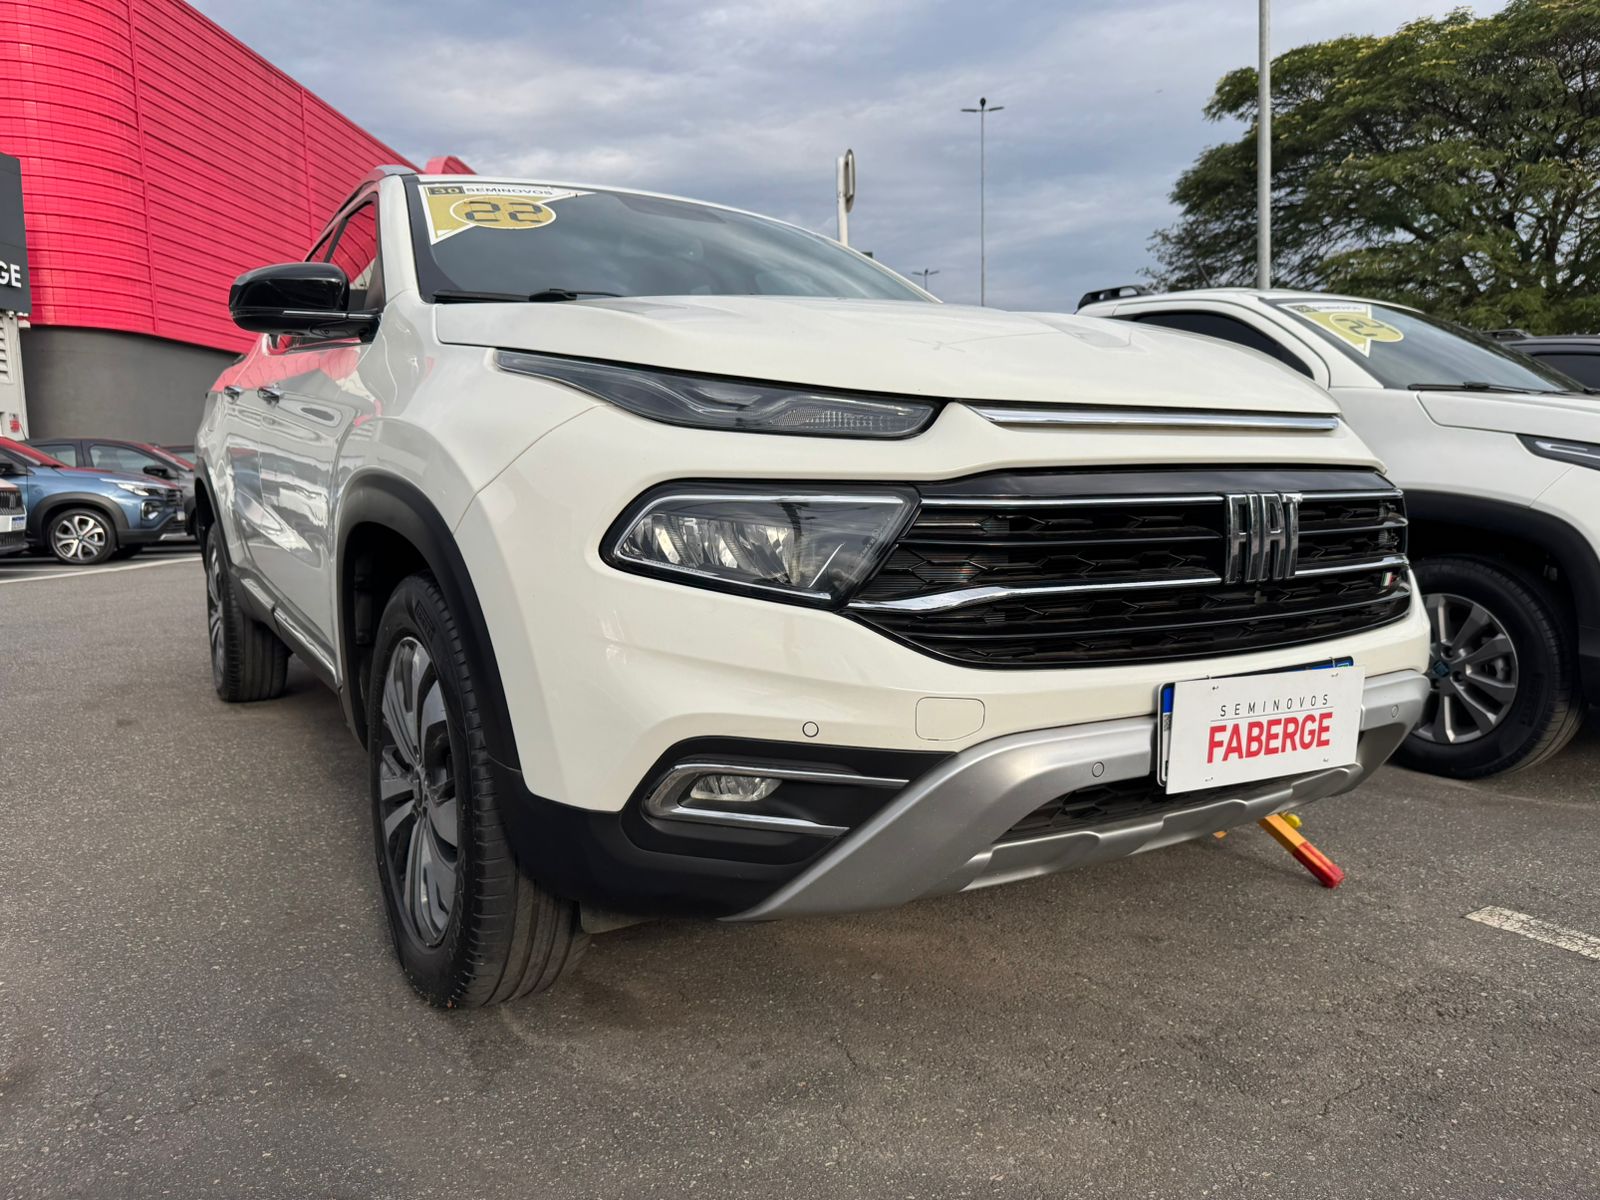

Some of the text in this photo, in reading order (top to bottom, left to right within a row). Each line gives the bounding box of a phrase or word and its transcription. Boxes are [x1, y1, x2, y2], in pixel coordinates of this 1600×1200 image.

[466, 187, 553, 196] SEMINOVOS
[464, 201, 543, 223] 22
[1225, 492, 1303, 584] FIAT
[1220, 694, 1329, 717] SEMINOVOS
[1207, 712, 1333, 764] FABERGE
